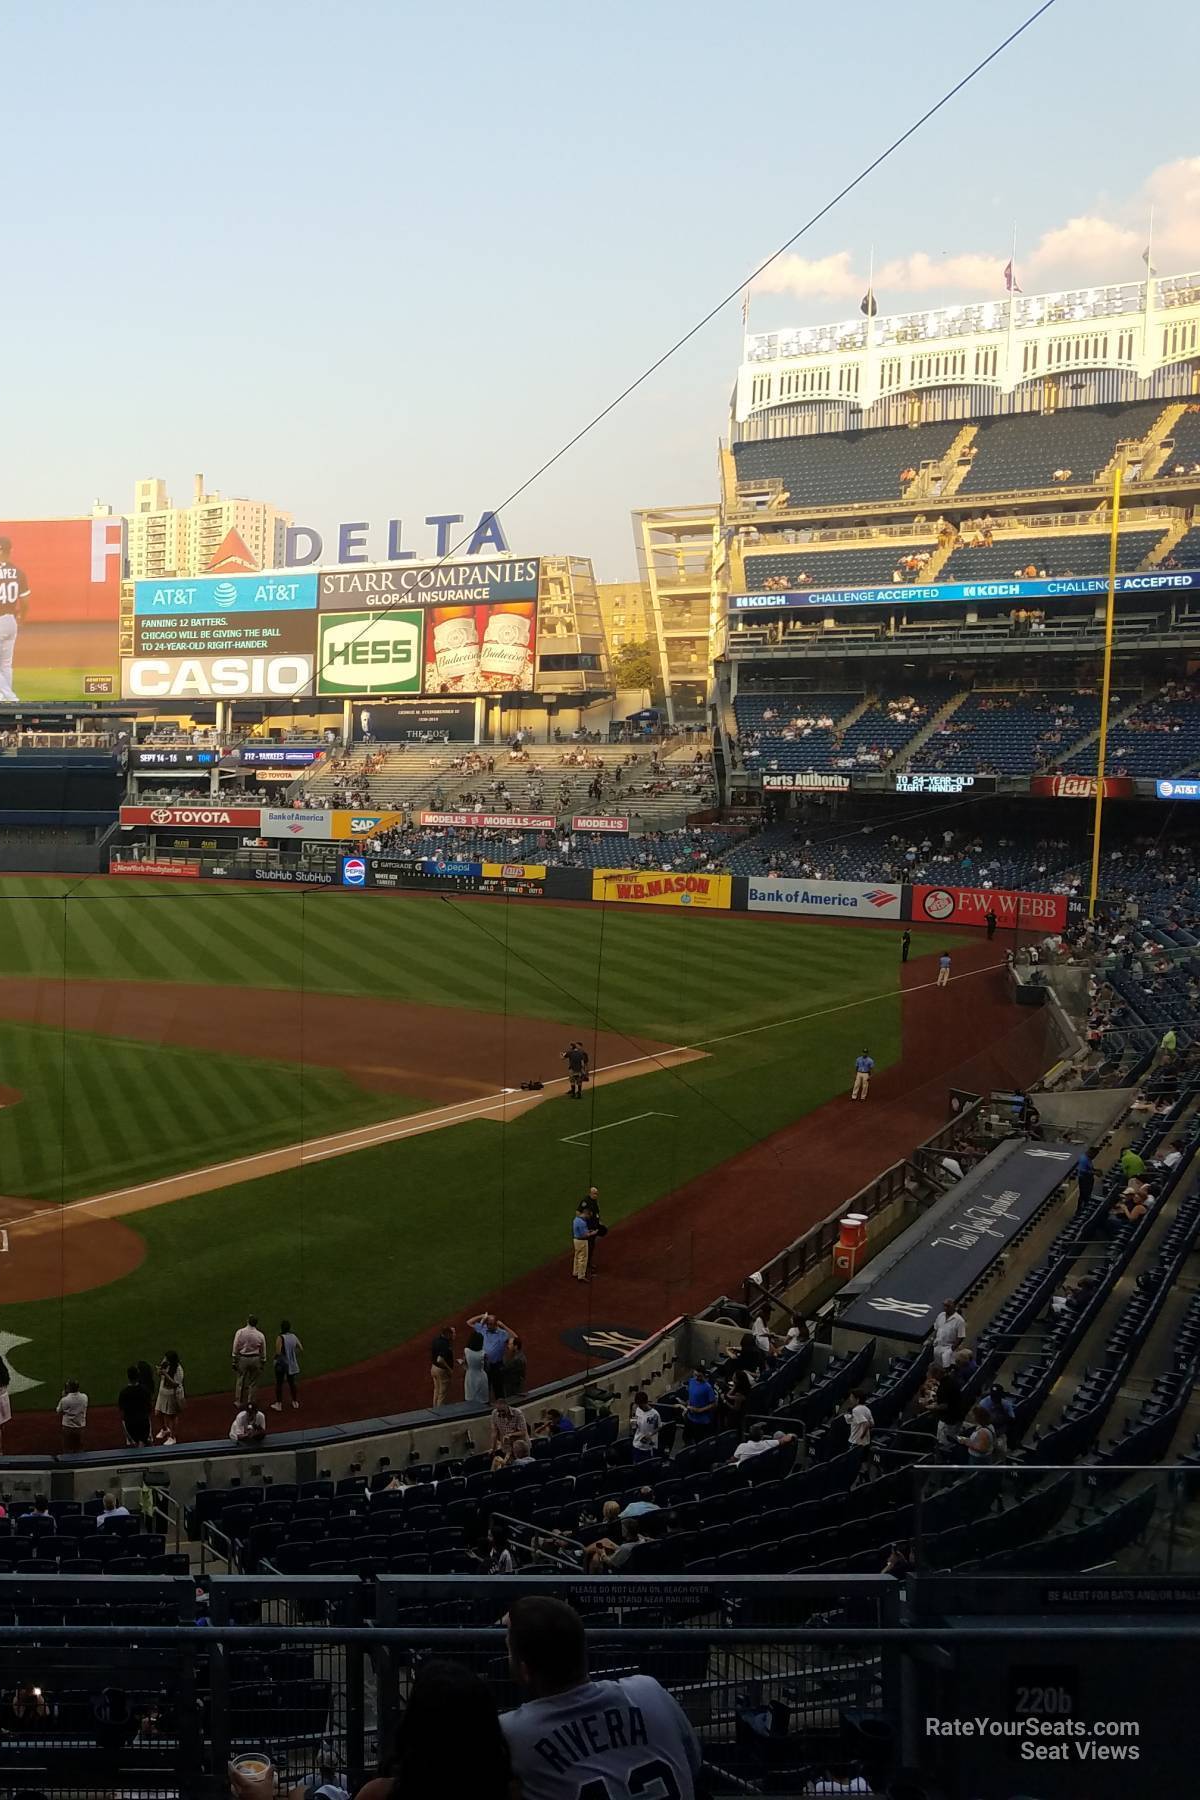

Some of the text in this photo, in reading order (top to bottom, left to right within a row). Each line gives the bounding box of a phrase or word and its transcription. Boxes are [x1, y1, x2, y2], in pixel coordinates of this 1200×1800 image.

[285, 510, 511, 567] DELTA
[323, 561, 538, 595] STARR COMPANIES
[152, 584, 300, 606] AT&T AT&T
[366, 587, 490, 607] GLOBAL INSURANCE
[749, 595, 786, 608] KOCH
[808, 591, 875, 604] CHALLENGE
[876, 588, 939, 601] ACCEPTED
[977, 584, 1019, 596] KOCH
[1124, 575, 1193, 589] ACCEPTED
[142, 617, 229, 629] FANNING 12 BATTERS.
[142, 628, 282, 641] CHICAGO WILL BE GIVING THE BALL
[141, 639, 269, 651] TO 24-YEAR-OLD RIGHT-HANDER
[329, 640, 412, 666] HESS
[129, 657, 310, 696] CASIO
[140, 754, 156, 762] SEPT
[762, 773, 851, 788] Parts Authority
[896, 776, 975, 786] TO 24-YEAR-OLD
[896, 783, 963, 793] RIGHT-HANDER
[173, 811, 231, 824] TOYOTA
[268, 812, 324, 822] Bank of America
[424, 814, 551, 827] MODELL'S MODELLS.com
[577, 818, 624, 829] MODELL'S
[351, 819, 375, 832] SAP
[243, 837, 269, 847] FedEx
[446, 862, 470, 873] pepsi
[255, 869, 332, 883] StubHub StubHub
[749, 888, 858, 908] Bank of America
[958, 892, 1057, 918] F.W. WEBB
[1015, 1687, 1072, 1714] 220b
[534, 1706, 649, 1774] RIVERA
